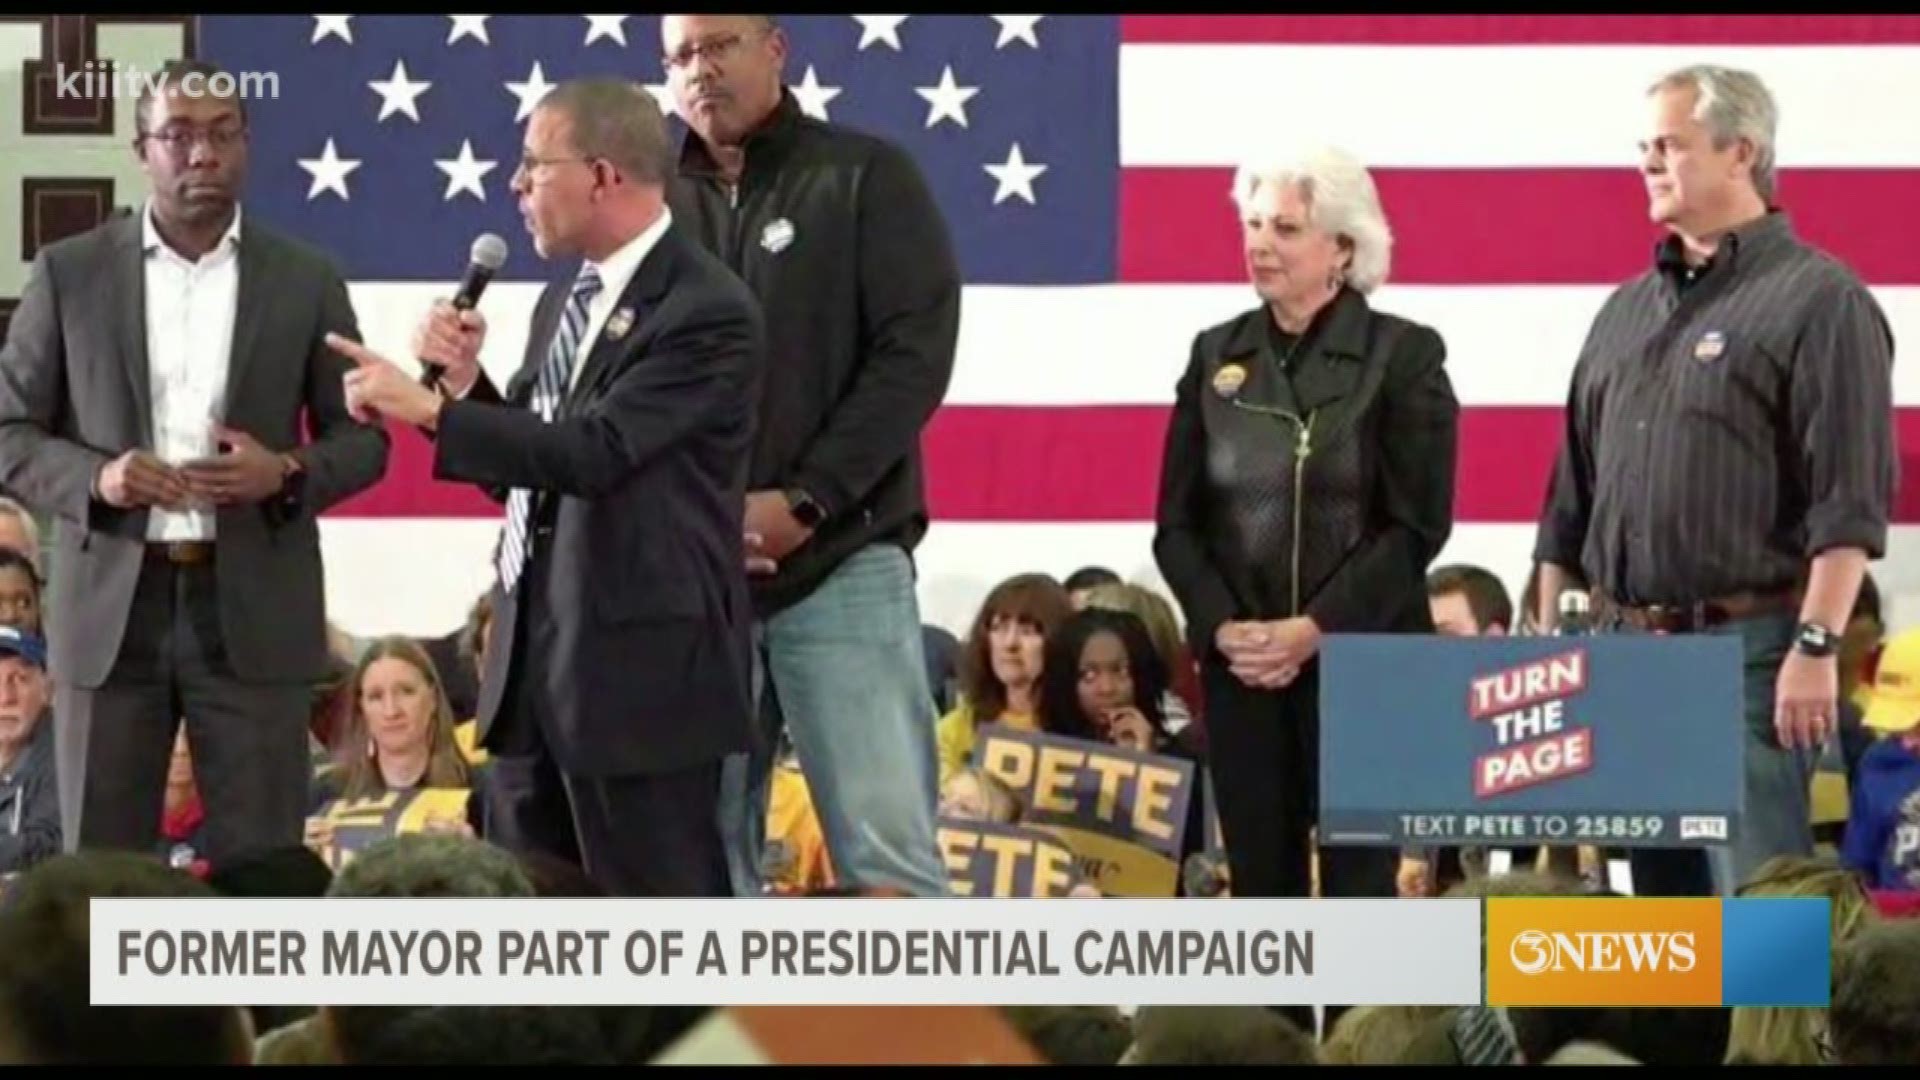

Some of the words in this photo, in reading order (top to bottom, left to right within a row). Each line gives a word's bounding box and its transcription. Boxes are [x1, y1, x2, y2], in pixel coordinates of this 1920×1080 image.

[1474, 656, 1582, 710] TURN
[1493, 701, 1564, 744] THE
[983, 738, 1183, 840] PETE
[1482, 737, 1586, 789] PAGE
[1402, 815, 1455, 836] TEXT
[1464, 815, 1525, 836] PETE
[1533, 815, 1567, 837] TO
[1575, 816, 1664, 838] 25859
[937, 826, 1074, 897] ETE
